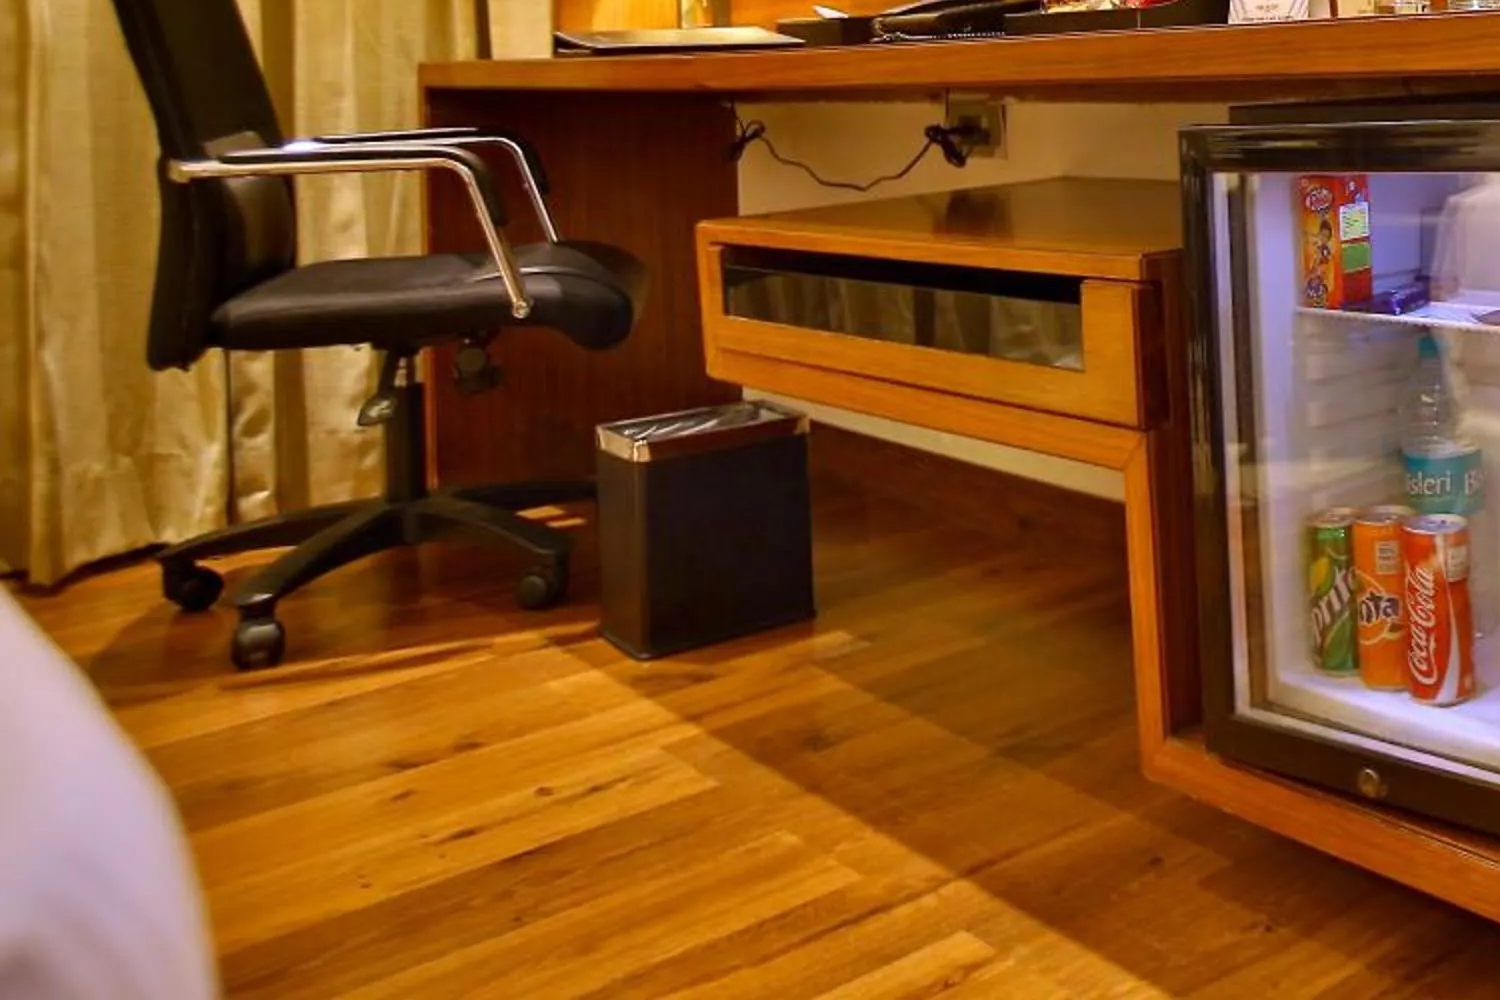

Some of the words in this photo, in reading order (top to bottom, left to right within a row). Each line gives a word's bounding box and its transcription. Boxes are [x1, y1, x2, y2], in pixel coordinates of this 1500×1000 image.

[1406, 469, 1451, 495] isleri
[1312, 566, 1357, 649] prit
[1360, 590, 1400, 625] nta
